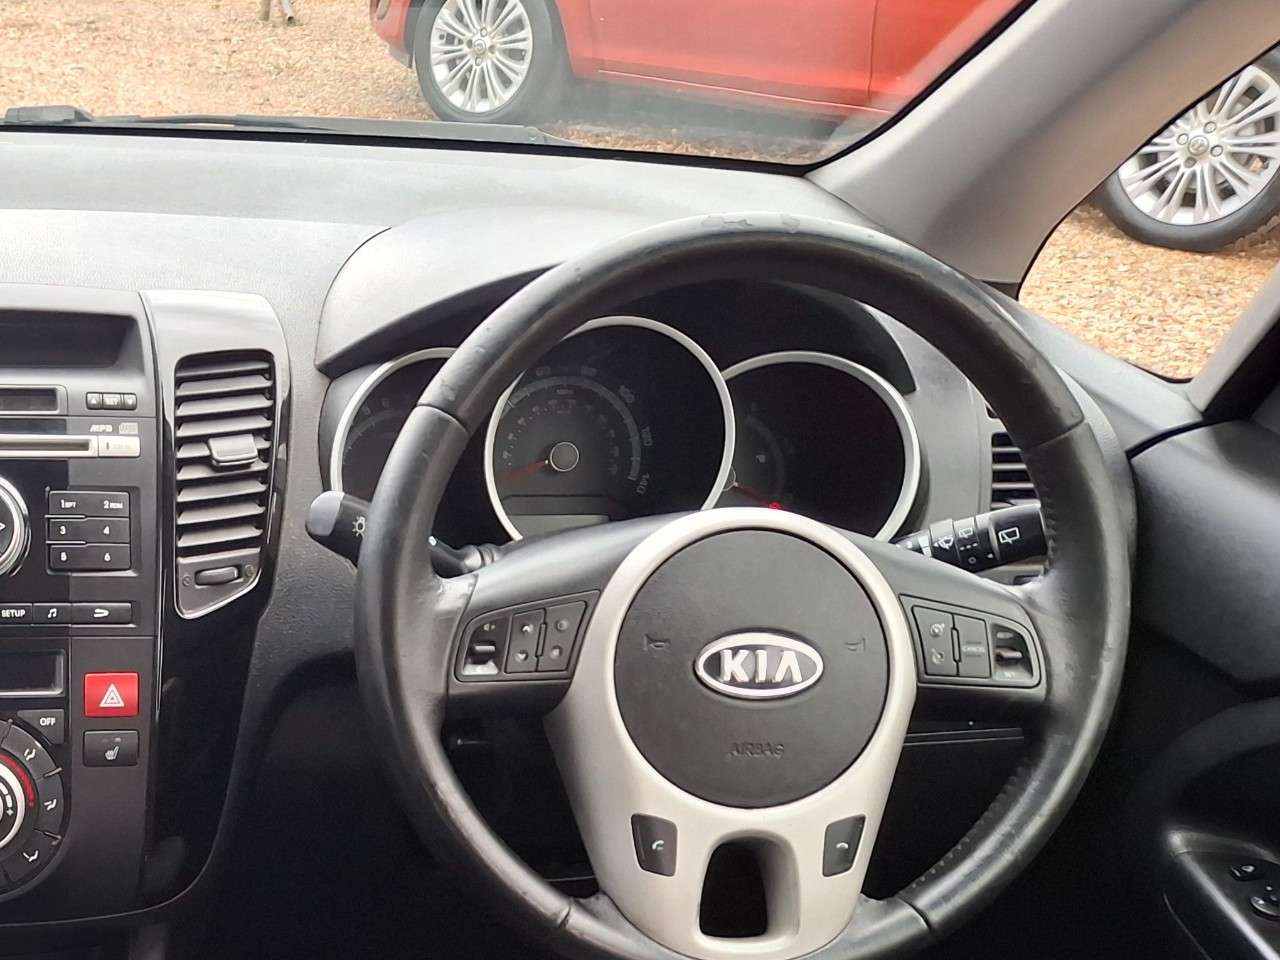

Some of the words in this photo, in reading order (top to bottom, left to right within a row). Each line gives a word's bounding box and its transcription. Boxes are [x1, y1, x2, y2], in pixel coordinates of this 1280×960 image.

[59, 525, 66, 535] 3
[103, 526, 110, 535] 4
[104, 552, 111, 562] 6
[1, 609, 26, 618] SETUP
[720, 649, 803, 684] KIA
[39, 717, 56, 726] OFF
[728, 741, 785, 758] AIRBAG
